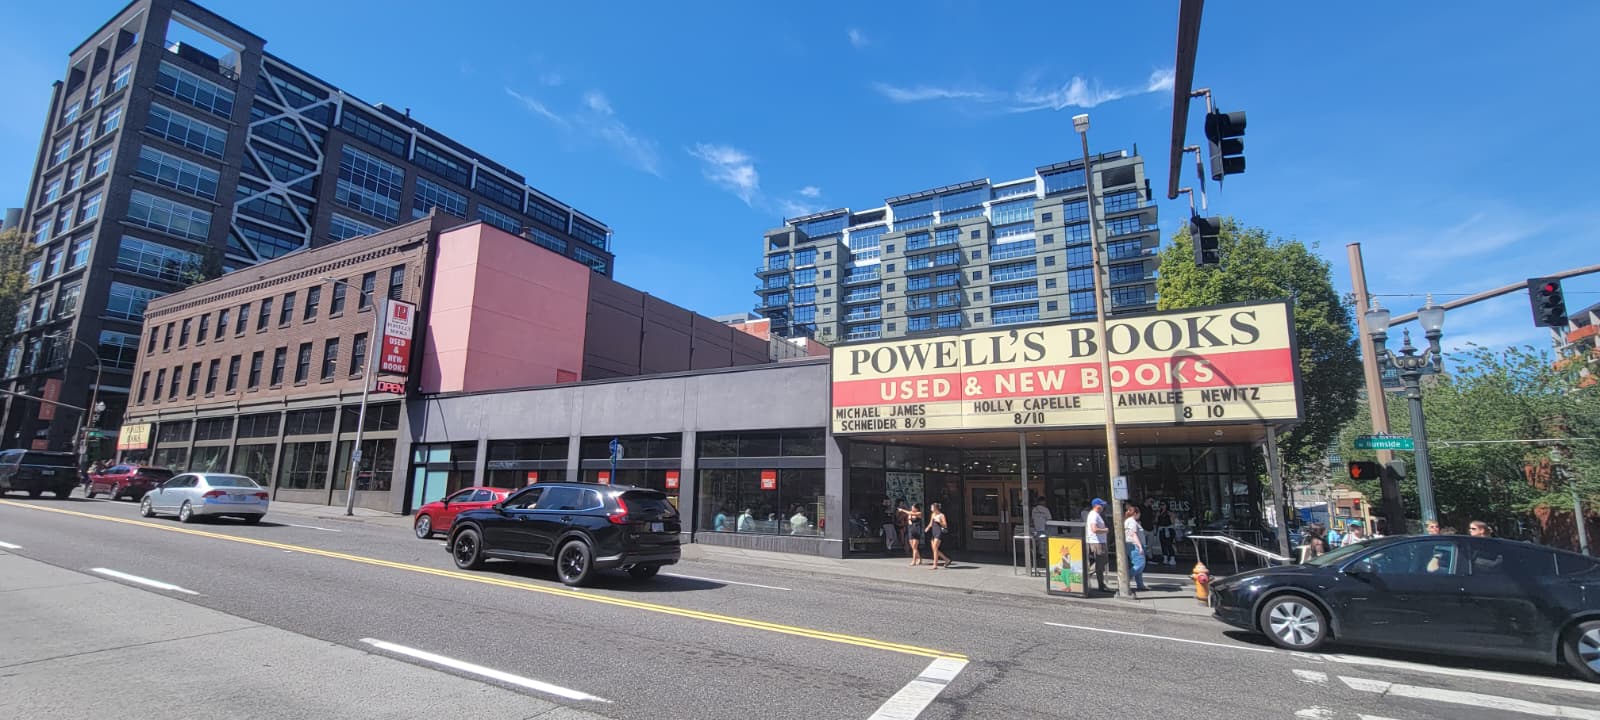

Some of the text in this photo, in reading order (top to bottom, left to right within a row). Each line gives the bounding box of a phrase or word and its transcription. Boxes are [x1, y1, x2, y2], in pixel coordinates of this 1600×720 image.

[389, 337, 406, 346] USED
[850, 310, 1260, 376] POWELL'S BOOKS
[393, 346, 399, 354] &
[387, 355, 403, 363] NEW
[383, 363, 406, 372] BOOKS
[377, 381, 405, 393] OPEN
[880, 360, 1214, 401] USED & NEW BOOKS
[1118, 387, 1260, 407] ANNALEE NEWITZ
[974, 395, 1081, 413] HOLLY CAPELLE
[835, 404, 926, 419] MICHAEL JAMES
[1014, 412, 1045, 424] 8/10
[1183, 404, 1224, 419] 8 10
[841, 417, 926, 431] SCHNEIDER 8/9
[1366, 440, 1401, 448] Burnside
